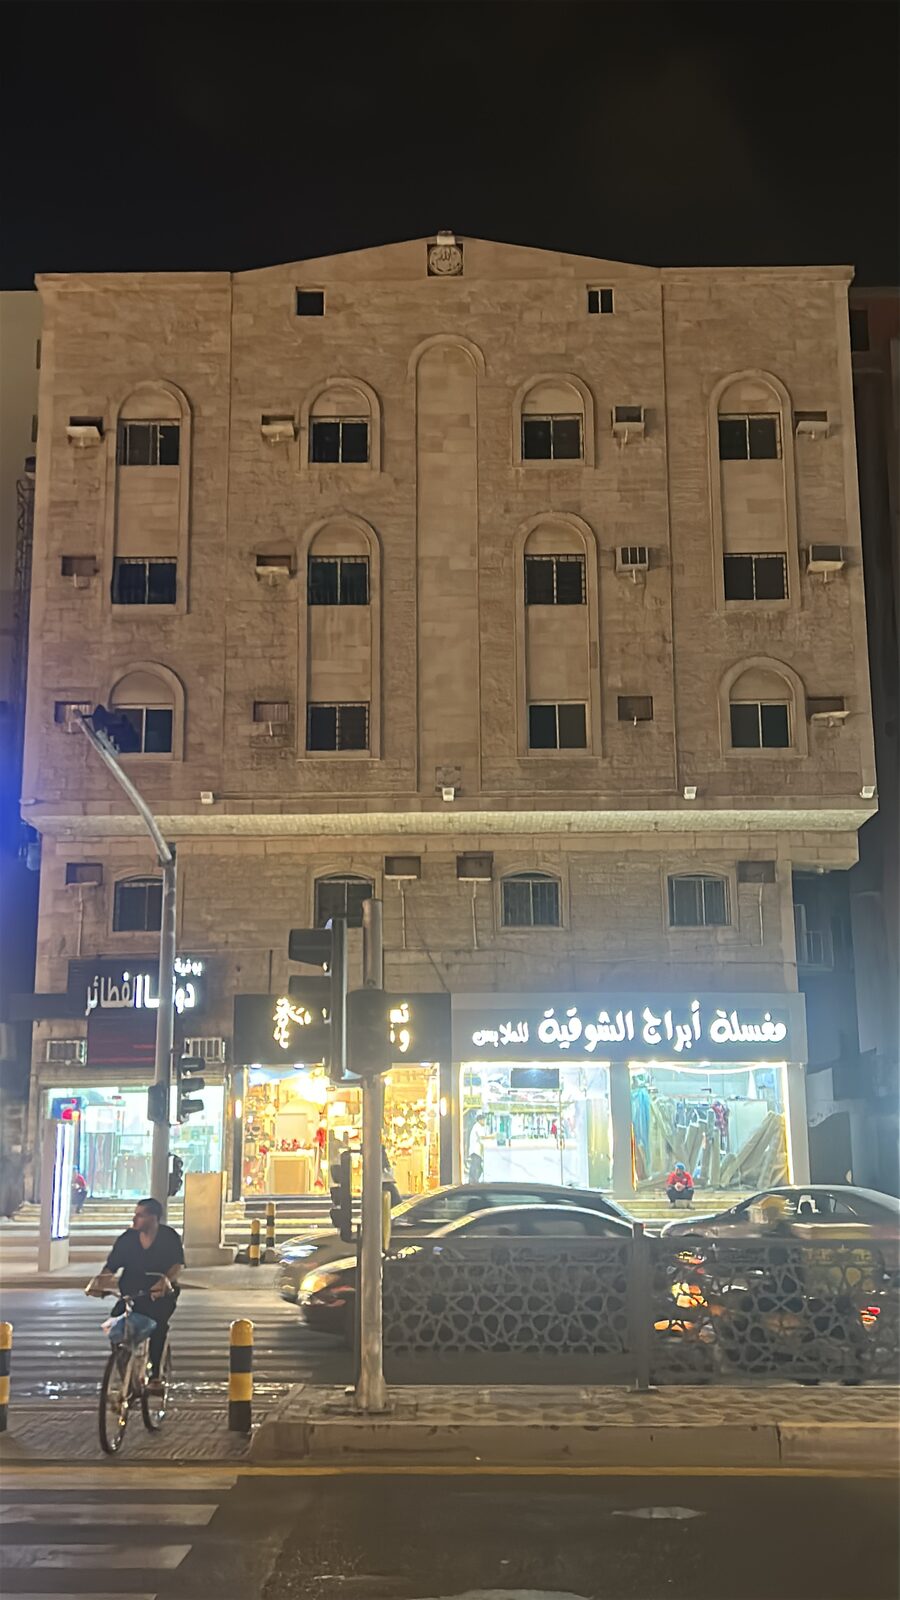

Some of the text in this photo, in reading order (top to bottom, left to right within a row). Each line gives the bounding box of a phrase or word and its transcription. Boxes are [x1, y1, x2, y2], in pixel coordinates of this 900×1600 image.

[85, 971, 143, 1016] الفطائر
[472, 1000, 786, 1052] مغسلة أبراج الشوقية للملابس
